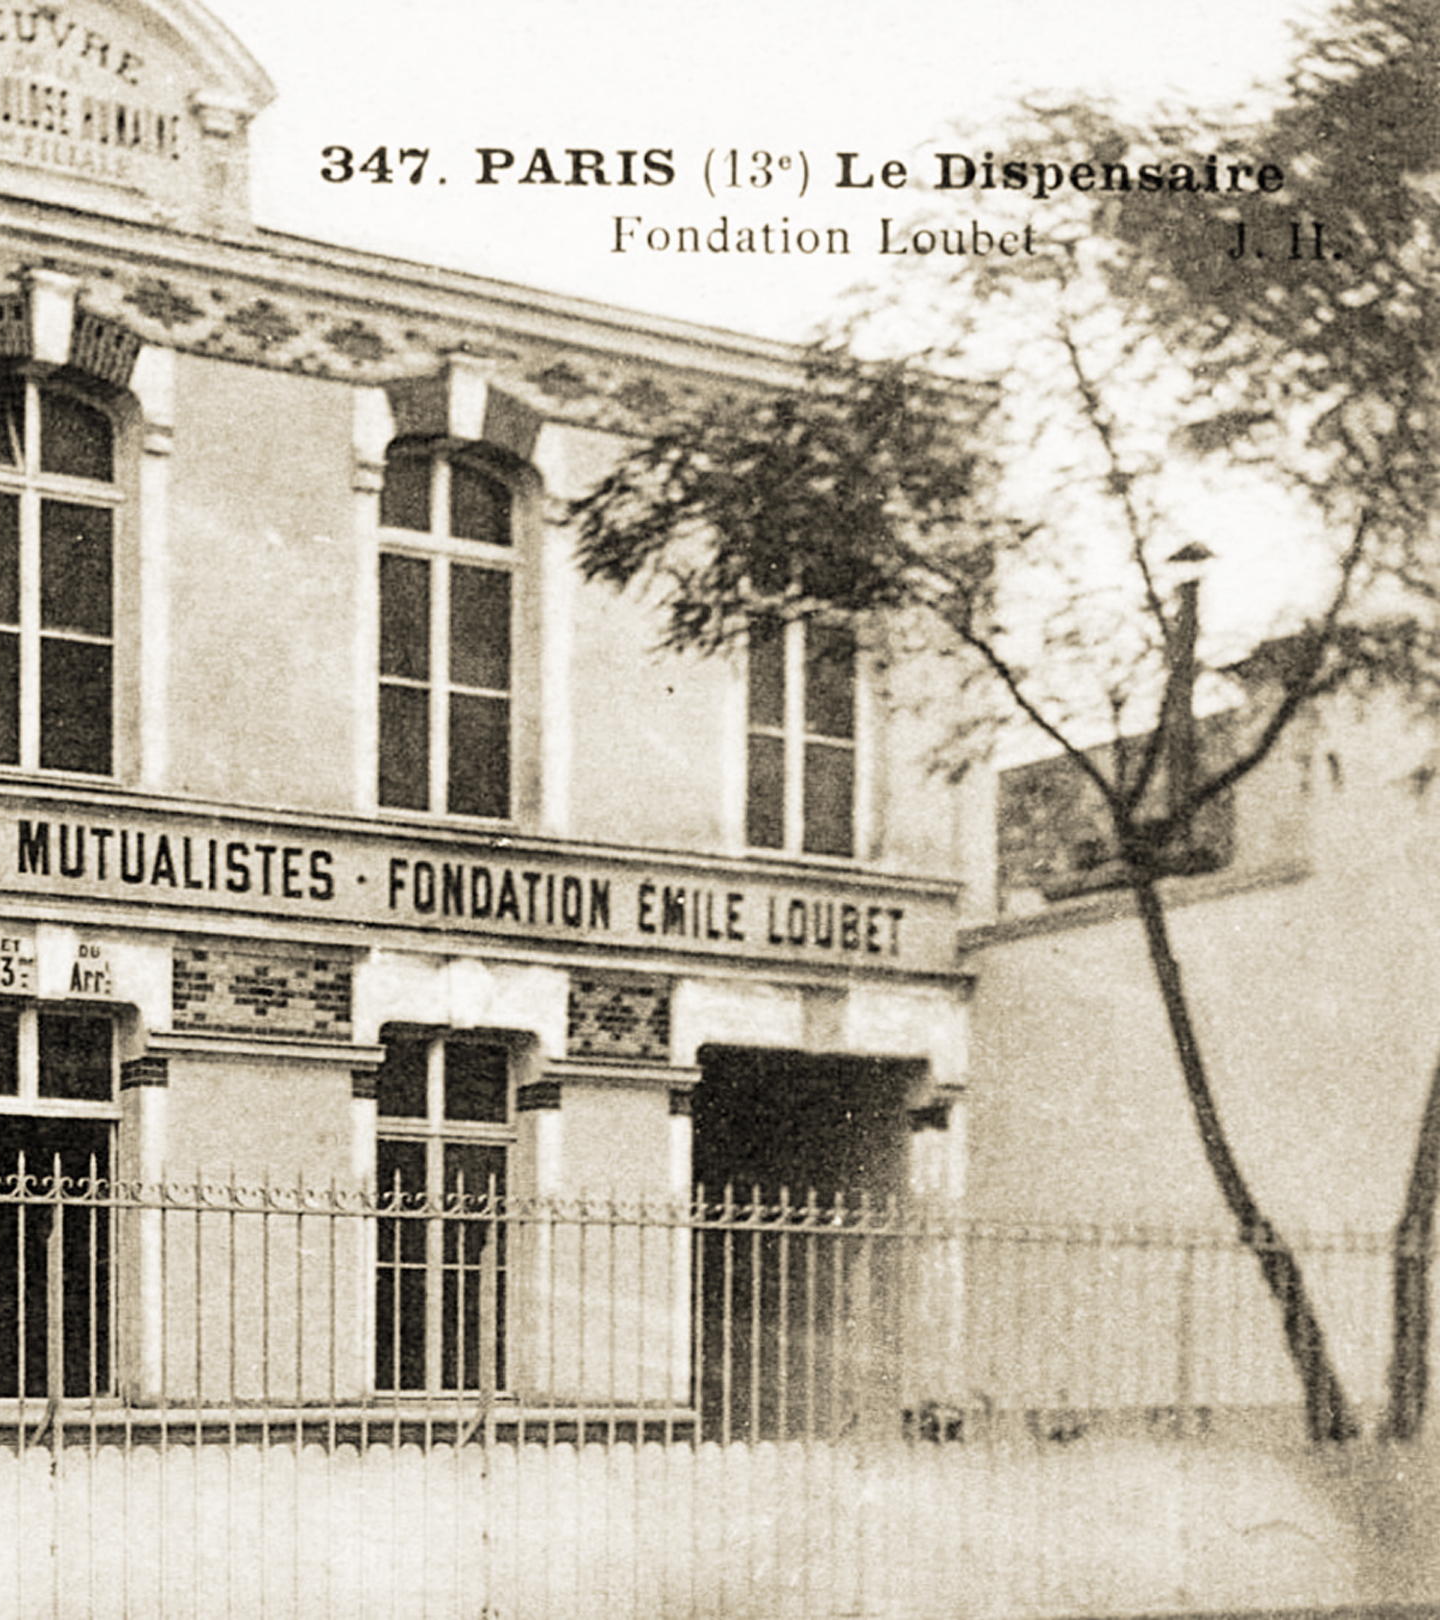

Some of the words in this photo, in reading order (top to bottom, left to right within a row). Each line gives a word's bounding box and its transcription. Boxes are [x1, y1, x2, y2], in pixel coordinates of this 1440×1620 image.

[17, 809, 334, 901] MUTUALISTES
[388, 856, 611, 931] FONDATION
[768, 894, 905, 956] LOUBET
[0, 938, 21, 952] ET
[78, 944, 101, 959] DU
